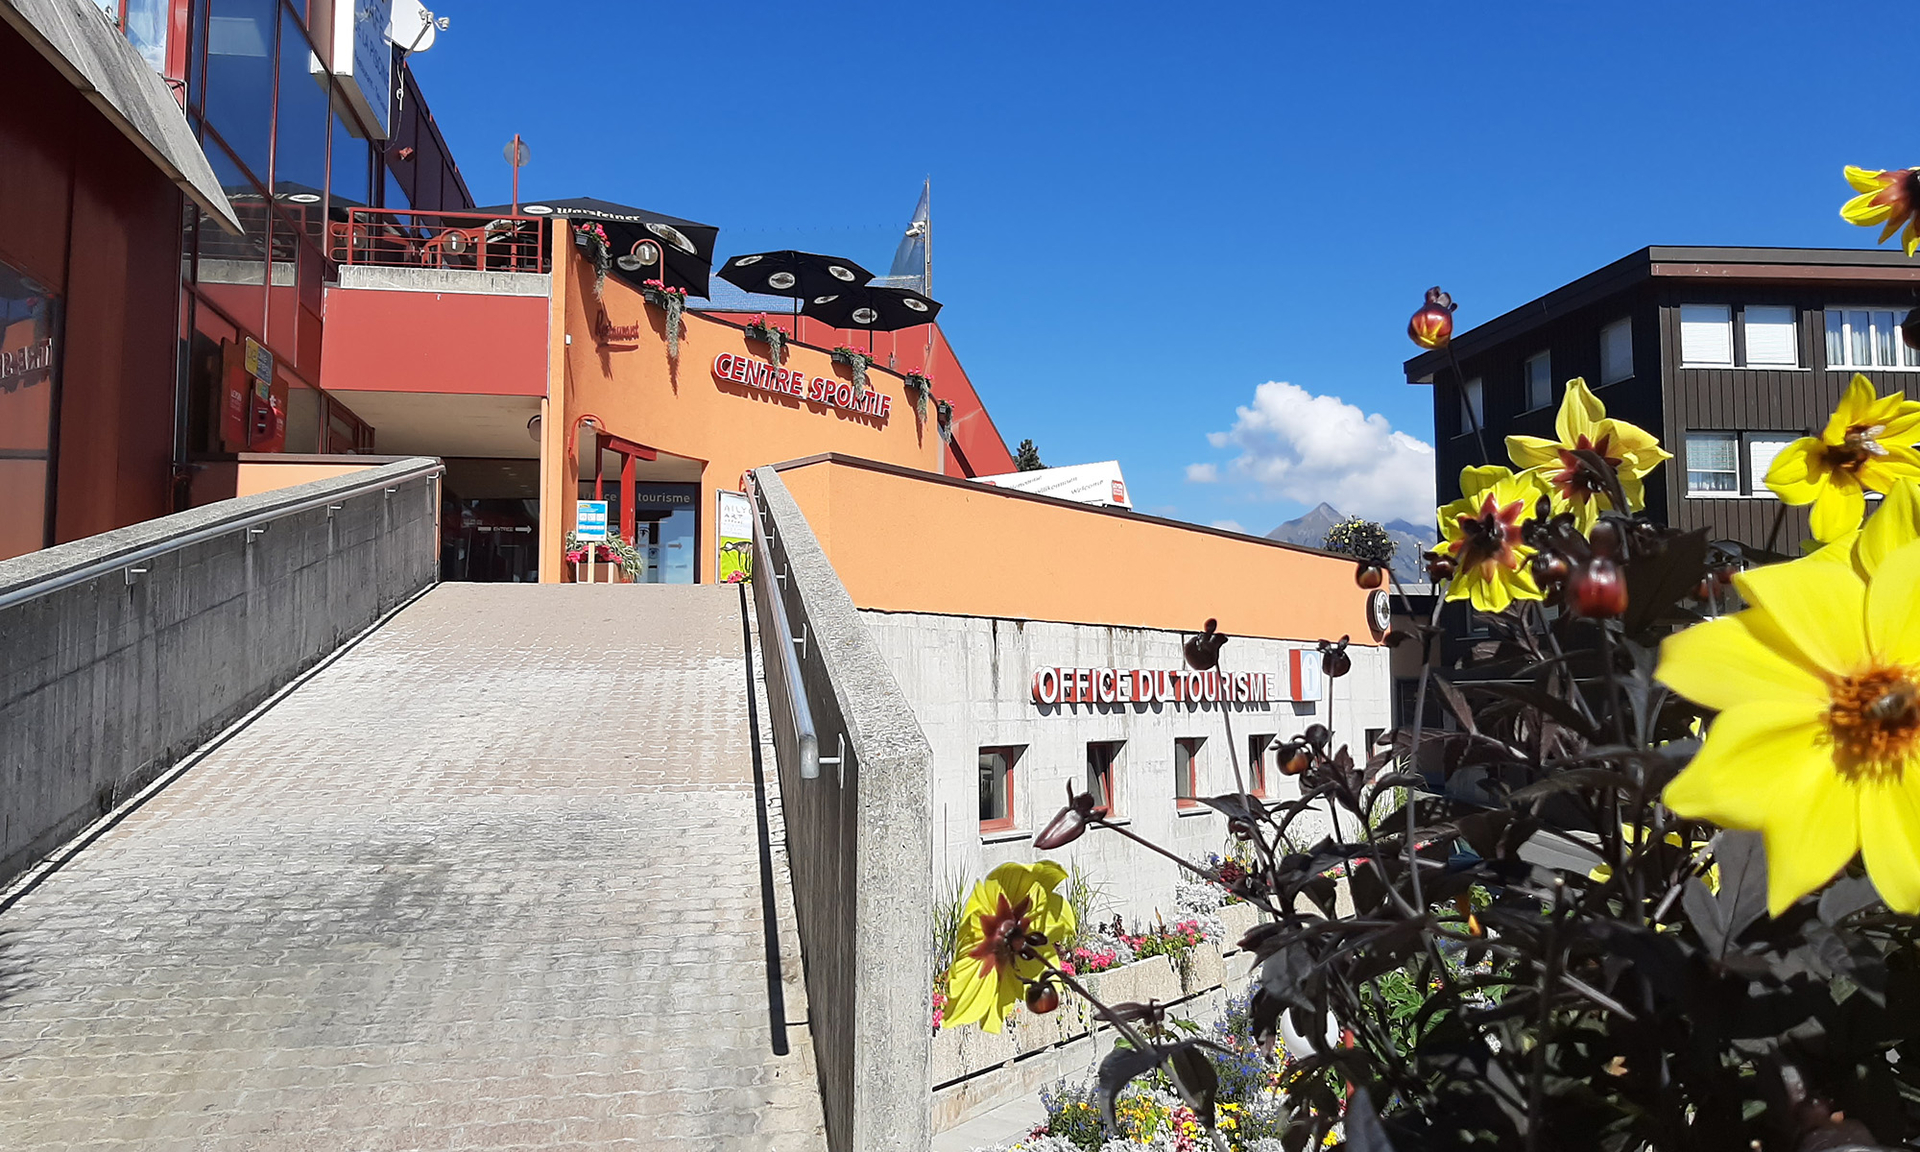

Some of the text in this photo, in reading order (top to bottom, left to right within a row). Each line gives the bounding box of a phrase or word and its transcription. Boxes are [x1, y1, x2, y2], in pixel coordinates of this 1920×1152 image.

[713, 353, 892, 418] CENTRE SPORTIF
[637, 492, 691, 503] tourisme
[1034, 666, 1276, 704] OFFICE DU TOURISME
